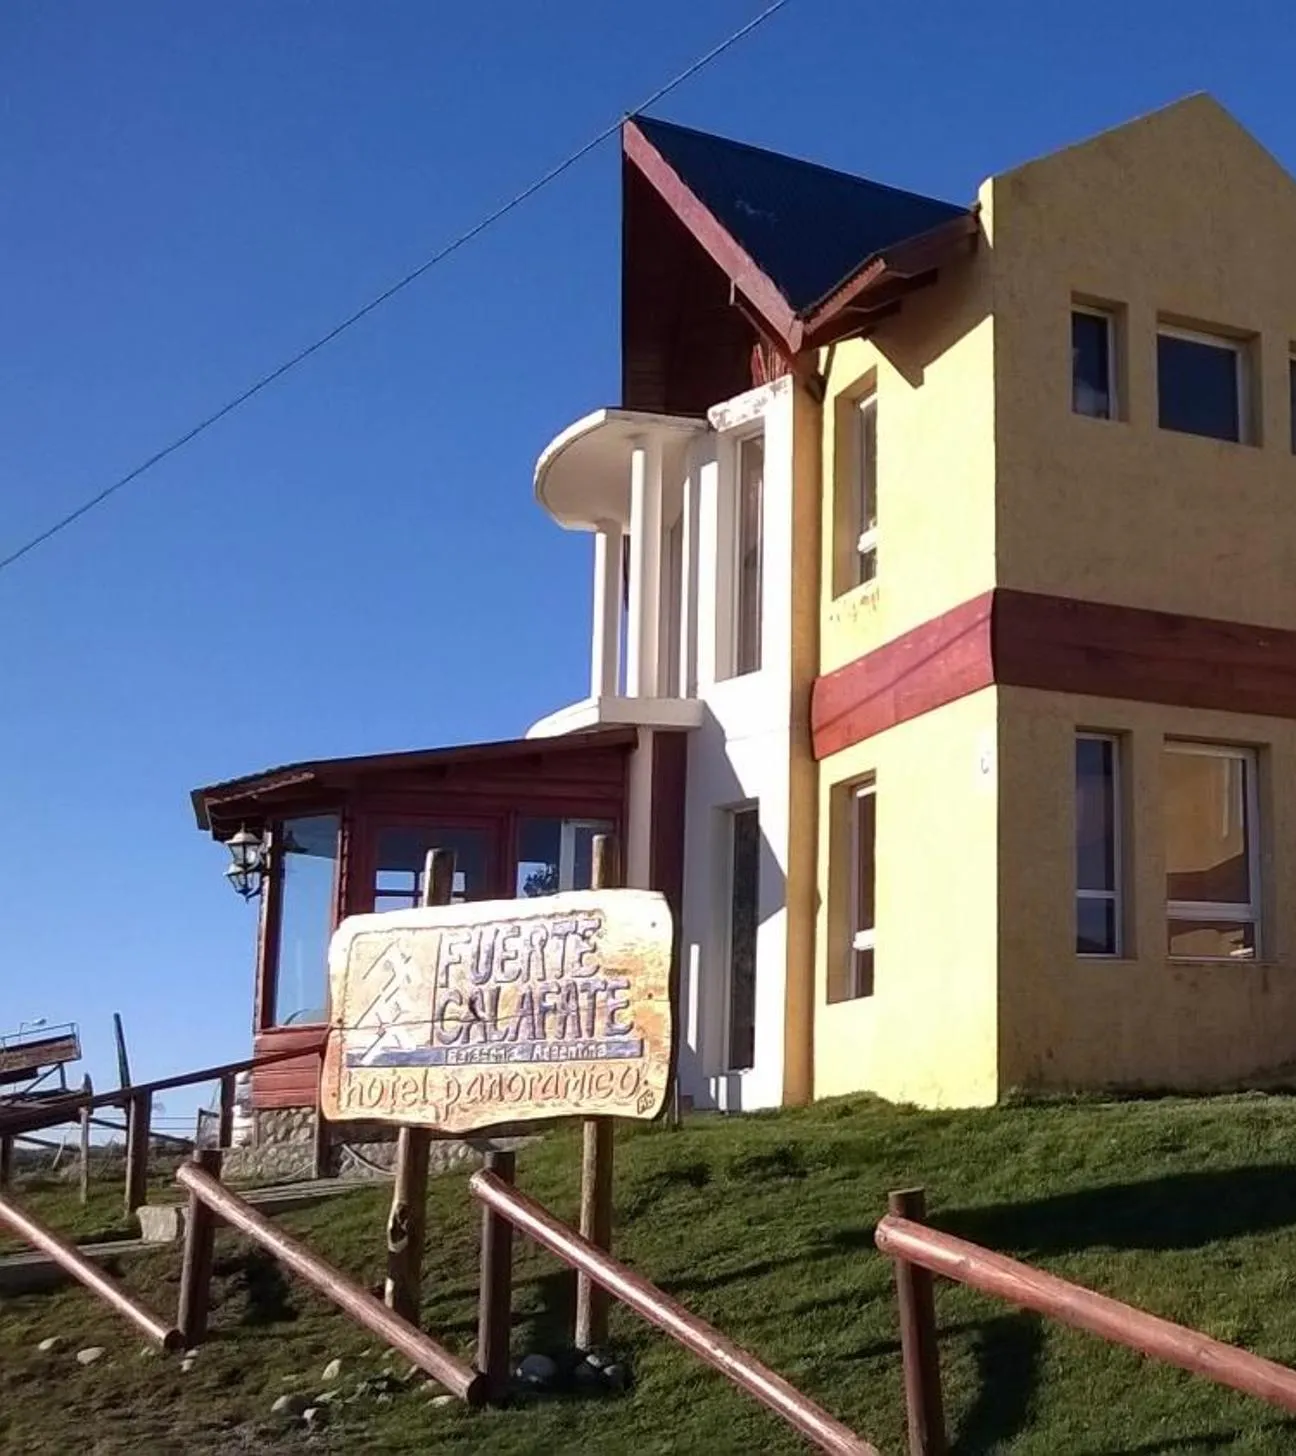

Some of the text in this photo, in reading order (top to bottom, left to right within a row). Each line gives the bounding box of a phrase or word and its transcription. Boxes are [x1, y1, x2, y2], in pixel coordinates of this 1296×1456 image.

[439, 917, 603, 988] FUERTE
[435, 978, 634, 1045] CALAFATE
[532, 1040, 608, 1061] Argentina
[345, 1067, 430, 1109] hotel
